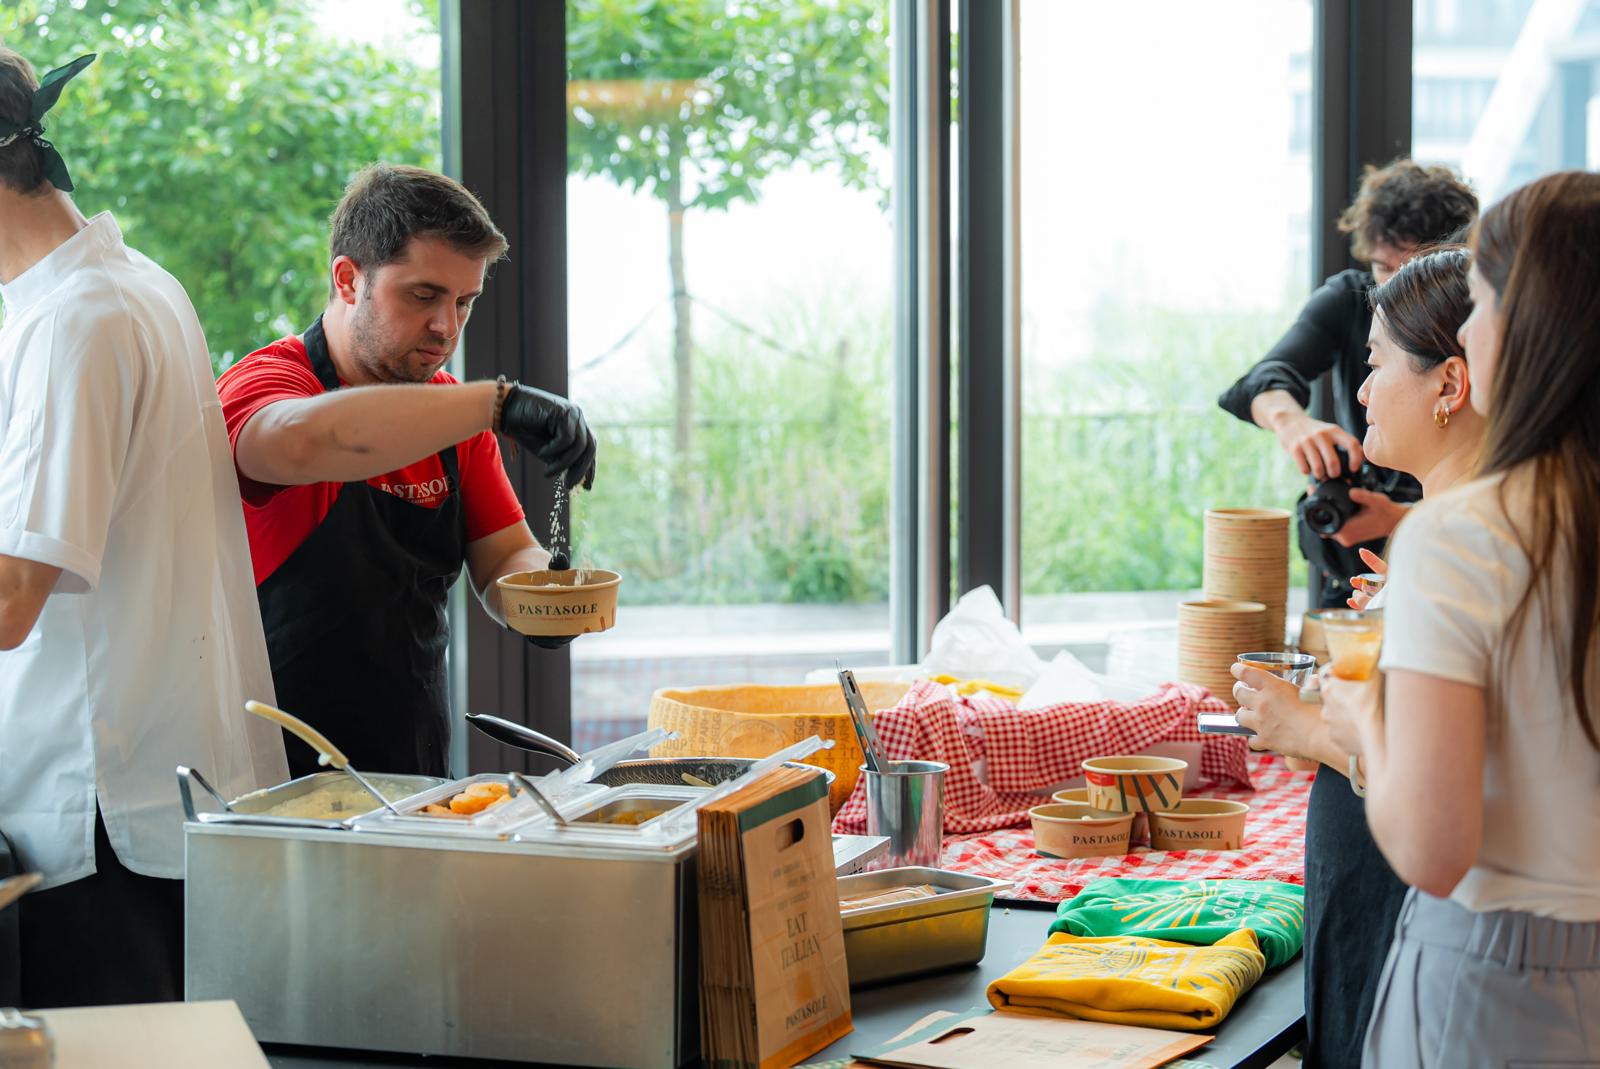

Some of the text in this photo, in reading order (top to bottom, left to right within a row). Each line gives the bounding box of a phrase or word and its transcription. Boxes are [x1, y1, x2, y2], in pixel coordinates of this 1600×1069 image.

[518, 603, 598, 616] PASTASOLE
[1158, 828, 1224, 840] PASTASOLE
[787, 911, 807, 938] EAT
